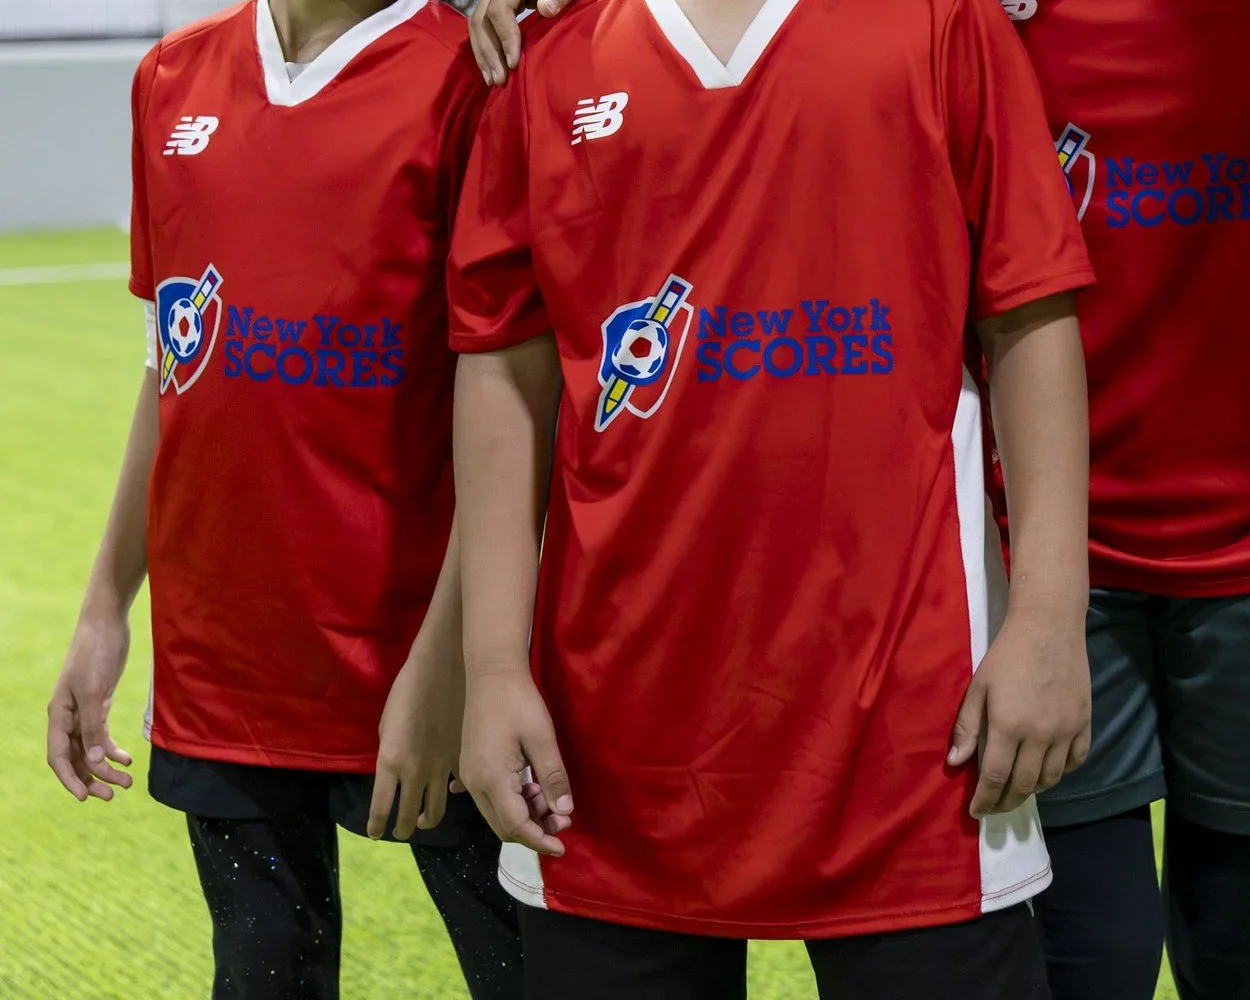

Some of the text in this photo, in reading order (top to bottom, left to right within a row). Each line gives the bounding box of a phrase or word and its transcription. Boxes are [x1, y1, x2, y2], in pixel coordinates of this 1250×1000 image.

[1104, 157, 1194, 187] New
[225, 305, 403, 348] New York
[697, 299, 892, 340] New York
[224, 341, 404, 388] SCORES
[696, 334, 893, 383] SCORES
